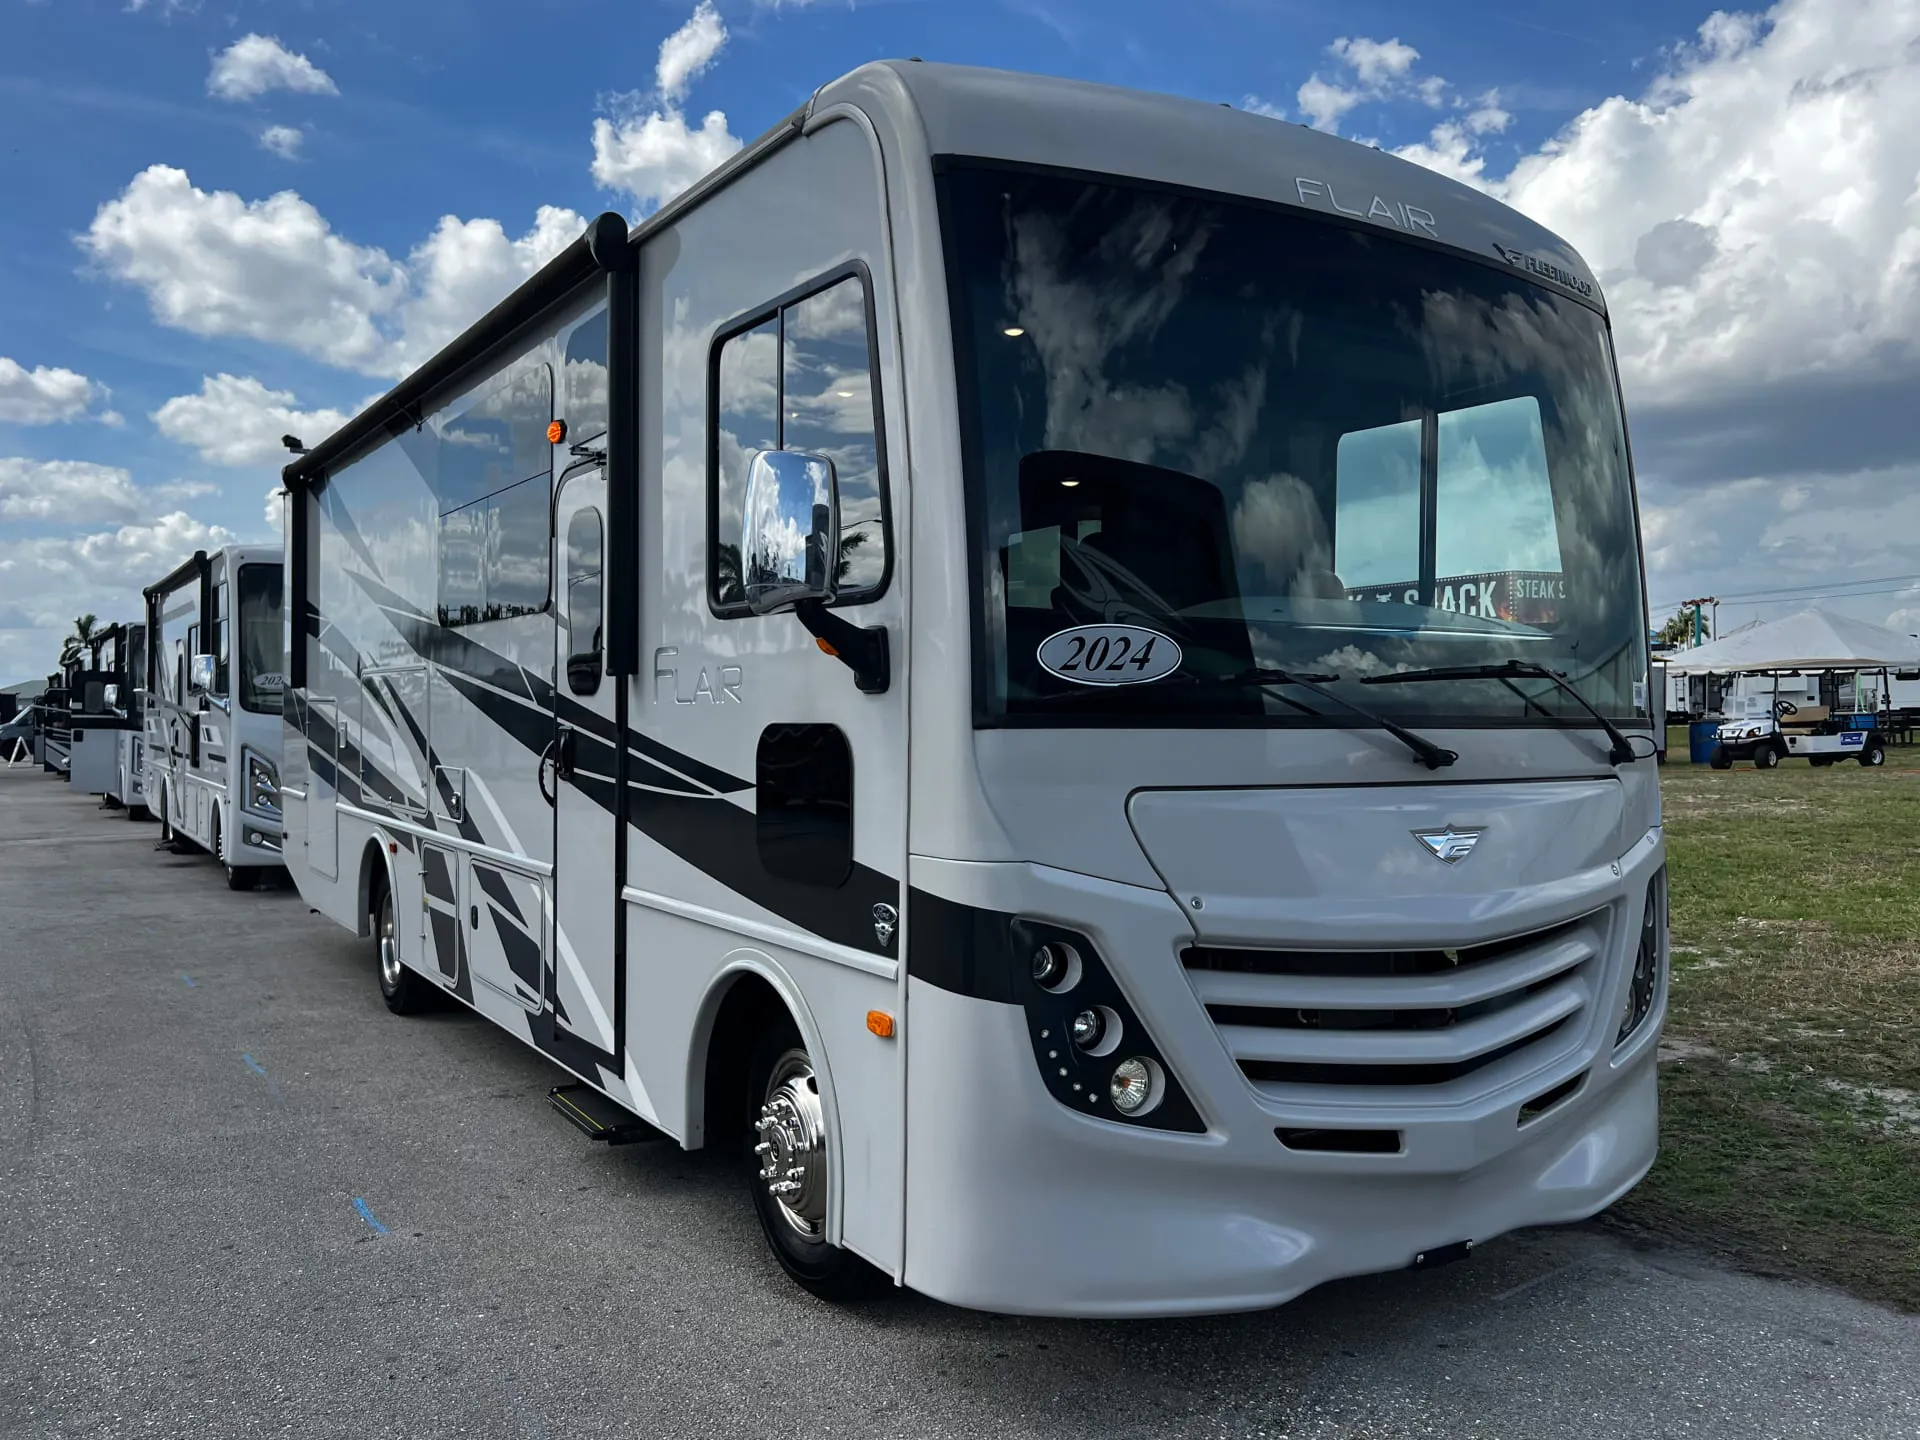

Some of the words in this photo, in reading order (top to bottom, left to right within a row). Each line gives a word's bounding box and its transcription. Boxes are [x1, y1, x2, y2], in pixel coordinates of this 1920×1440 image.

[1294, 177, 1438, 238] FLAIR
[1523, 255, 1593, 297] FLEETWOOD
[1404, 581, 1497, 618] SACK
[1516, 580, 1555, 599] STEAK
[1058, 636, 1157, 671] 2024
[654, 646, 743, 704] FLAIR
